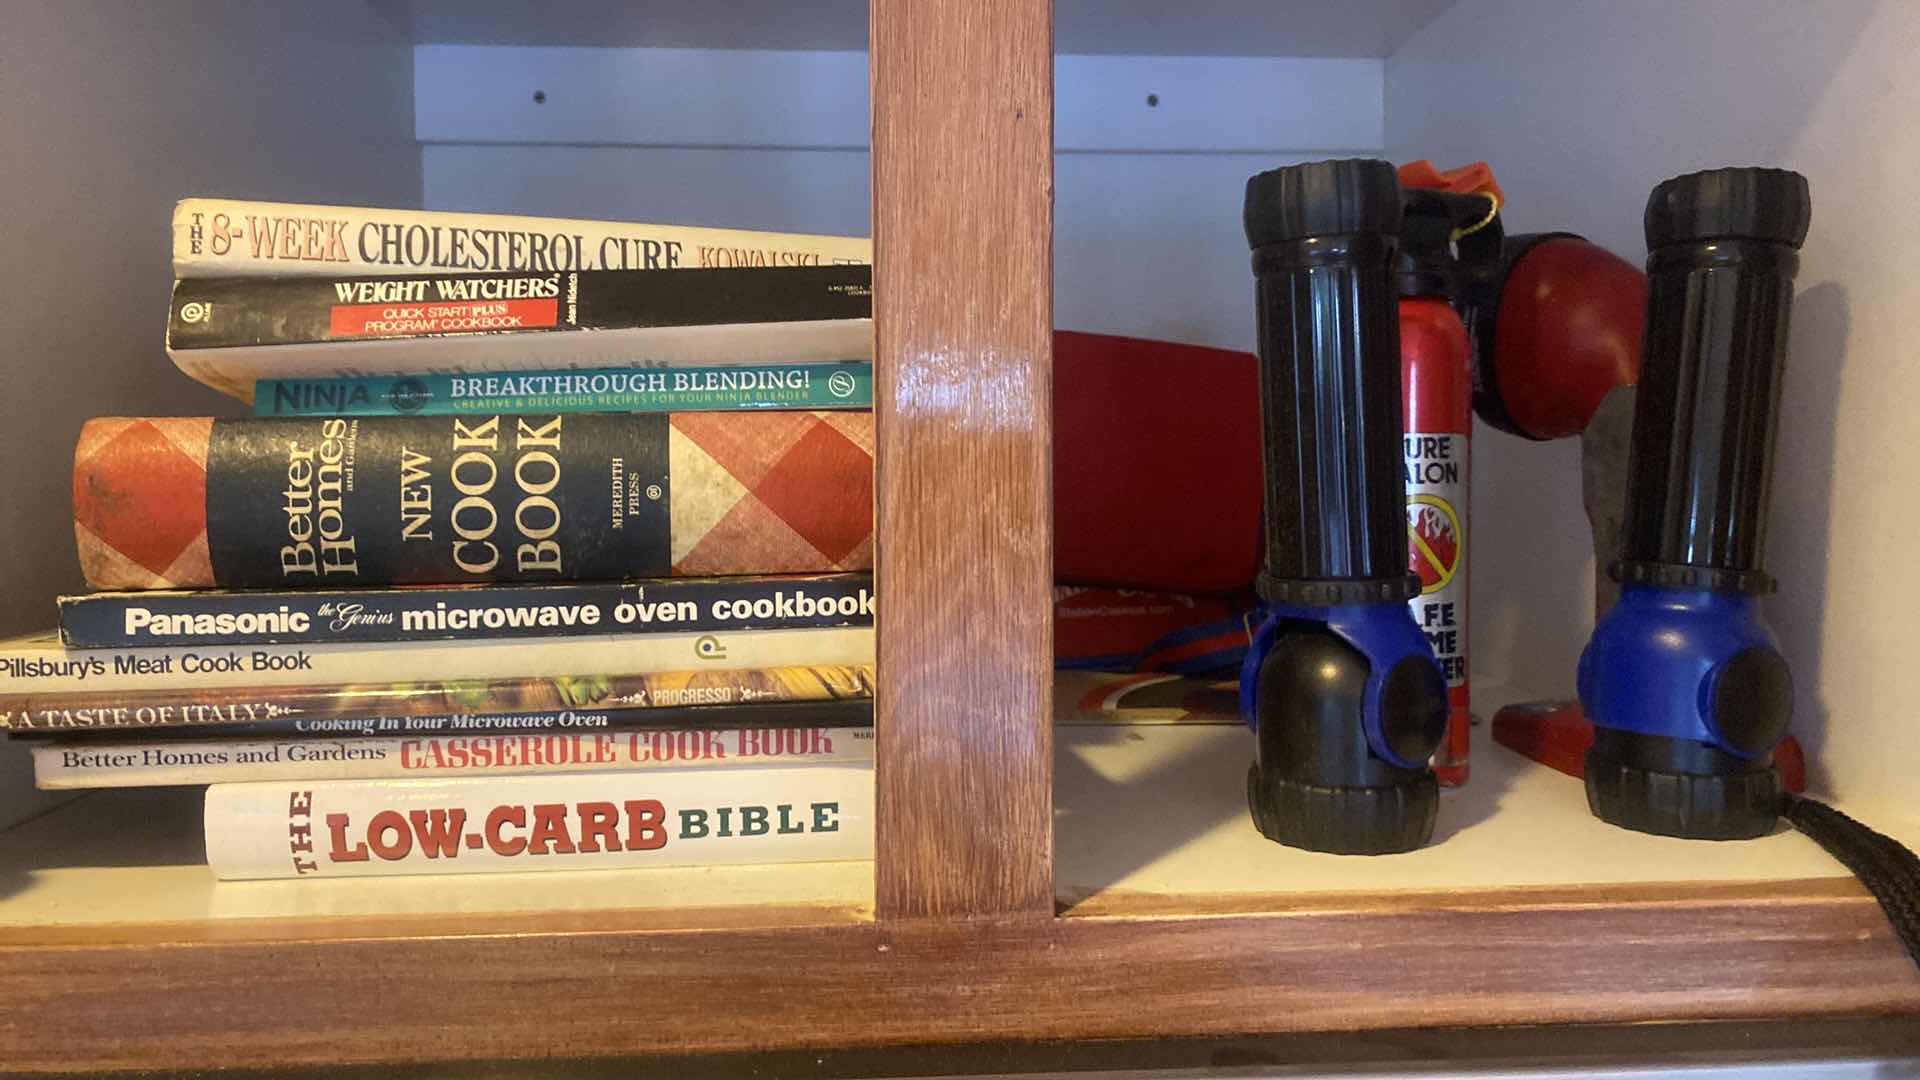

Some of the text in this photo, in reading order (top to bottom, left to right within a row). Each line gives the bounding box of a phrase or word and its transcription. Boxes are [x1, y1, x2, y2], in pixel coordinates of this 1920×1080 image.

[191, 212, 204, 256] THE
[210, 213, 350, 263] 8-WEEK
[358, 222, 593, 273] CHOLESTEROL
[600, 236, 683, 271] CURE
[335, 281, 430, 304] WEIGHT
[383, 304, 507, 320] QUICK START PLUS
[441, 316, 522, 329] COOKBOOK
[566, 304, 577, 326] Jean
[451, 370, 811, 397] BREAKTHROUGH BLENDING!
[453, 389, 809, 409] CREATIVE & DELICIOUS RECIPES FOR YOUR NINJA BLENDER
[1405, 436, 1450, 459] URE
[345, 468, 354, 492] and
[401, 446, 433, 542] NEW
[451, 415, 500, 574] COOK
[514, 415, 562, 574] BOOK
[612, 458, 624, 529] MEREDITH
[629, 472, 640, 516] PRESS
[281, 441, 318, 577] Better
[318, 418, 359, 576] Homes
[125, 589, 875, 636] Panasonic the Genius microwave oven cookbook
[0, 651, 312, 680] Pillsbury's Meat Cook Book
[653, 687, 731, 705] PROGRESSO
[17, 704, 262, 729] A TASTE OF ITALY
[295, 711, 607, 735] Cooking In Your Microwave Oven
[63, 750, 137, 768] Better
[143, 748, 228, 767] Homes
[236, 746, 280, 763] and
[287, 744, 386, 763] Gardens
[400, 733, 616, 769] CASSEROLE
[629, 730, 727, 763] COOK
[737, 728, 835, 757] BOOK
[289, 791, 840, 874] THE LOW-CARB BIBLE
